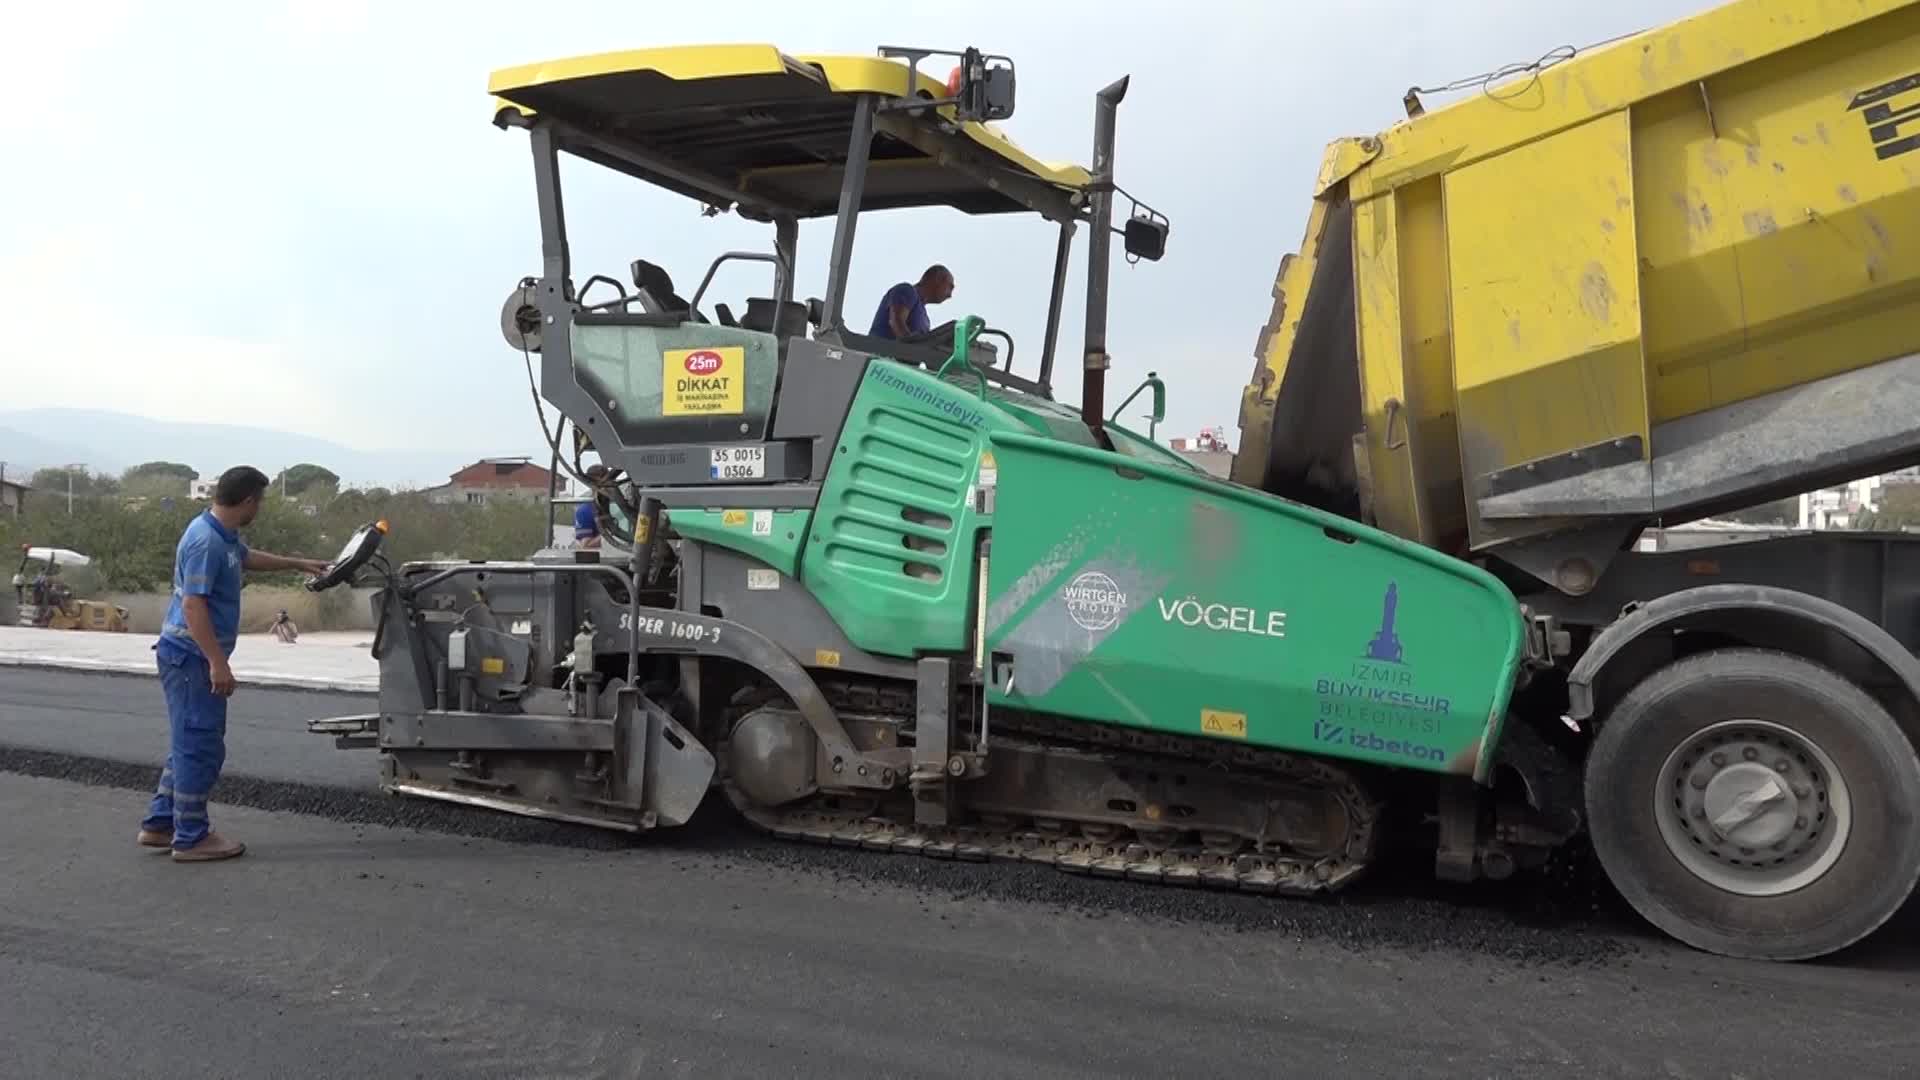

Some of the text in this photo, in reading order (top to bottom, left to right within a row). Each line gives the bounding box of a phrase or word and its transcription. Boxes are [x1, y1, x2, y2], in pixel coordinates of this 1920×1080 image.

[689, 355, 717, 370] 25m
[677, 377, 729, 392] DİKKAT
[714, 449, 761, 462] 35 0015
[1064, 586, 1127, 604] WIRTGEN
[1067, 600, 1120, 614] GROUP
[1158, 592, 1287, 637] VÖGELE
[670, 621, 721, 643] 1600-3
[1350, 728, 1445, 761] izbeton
